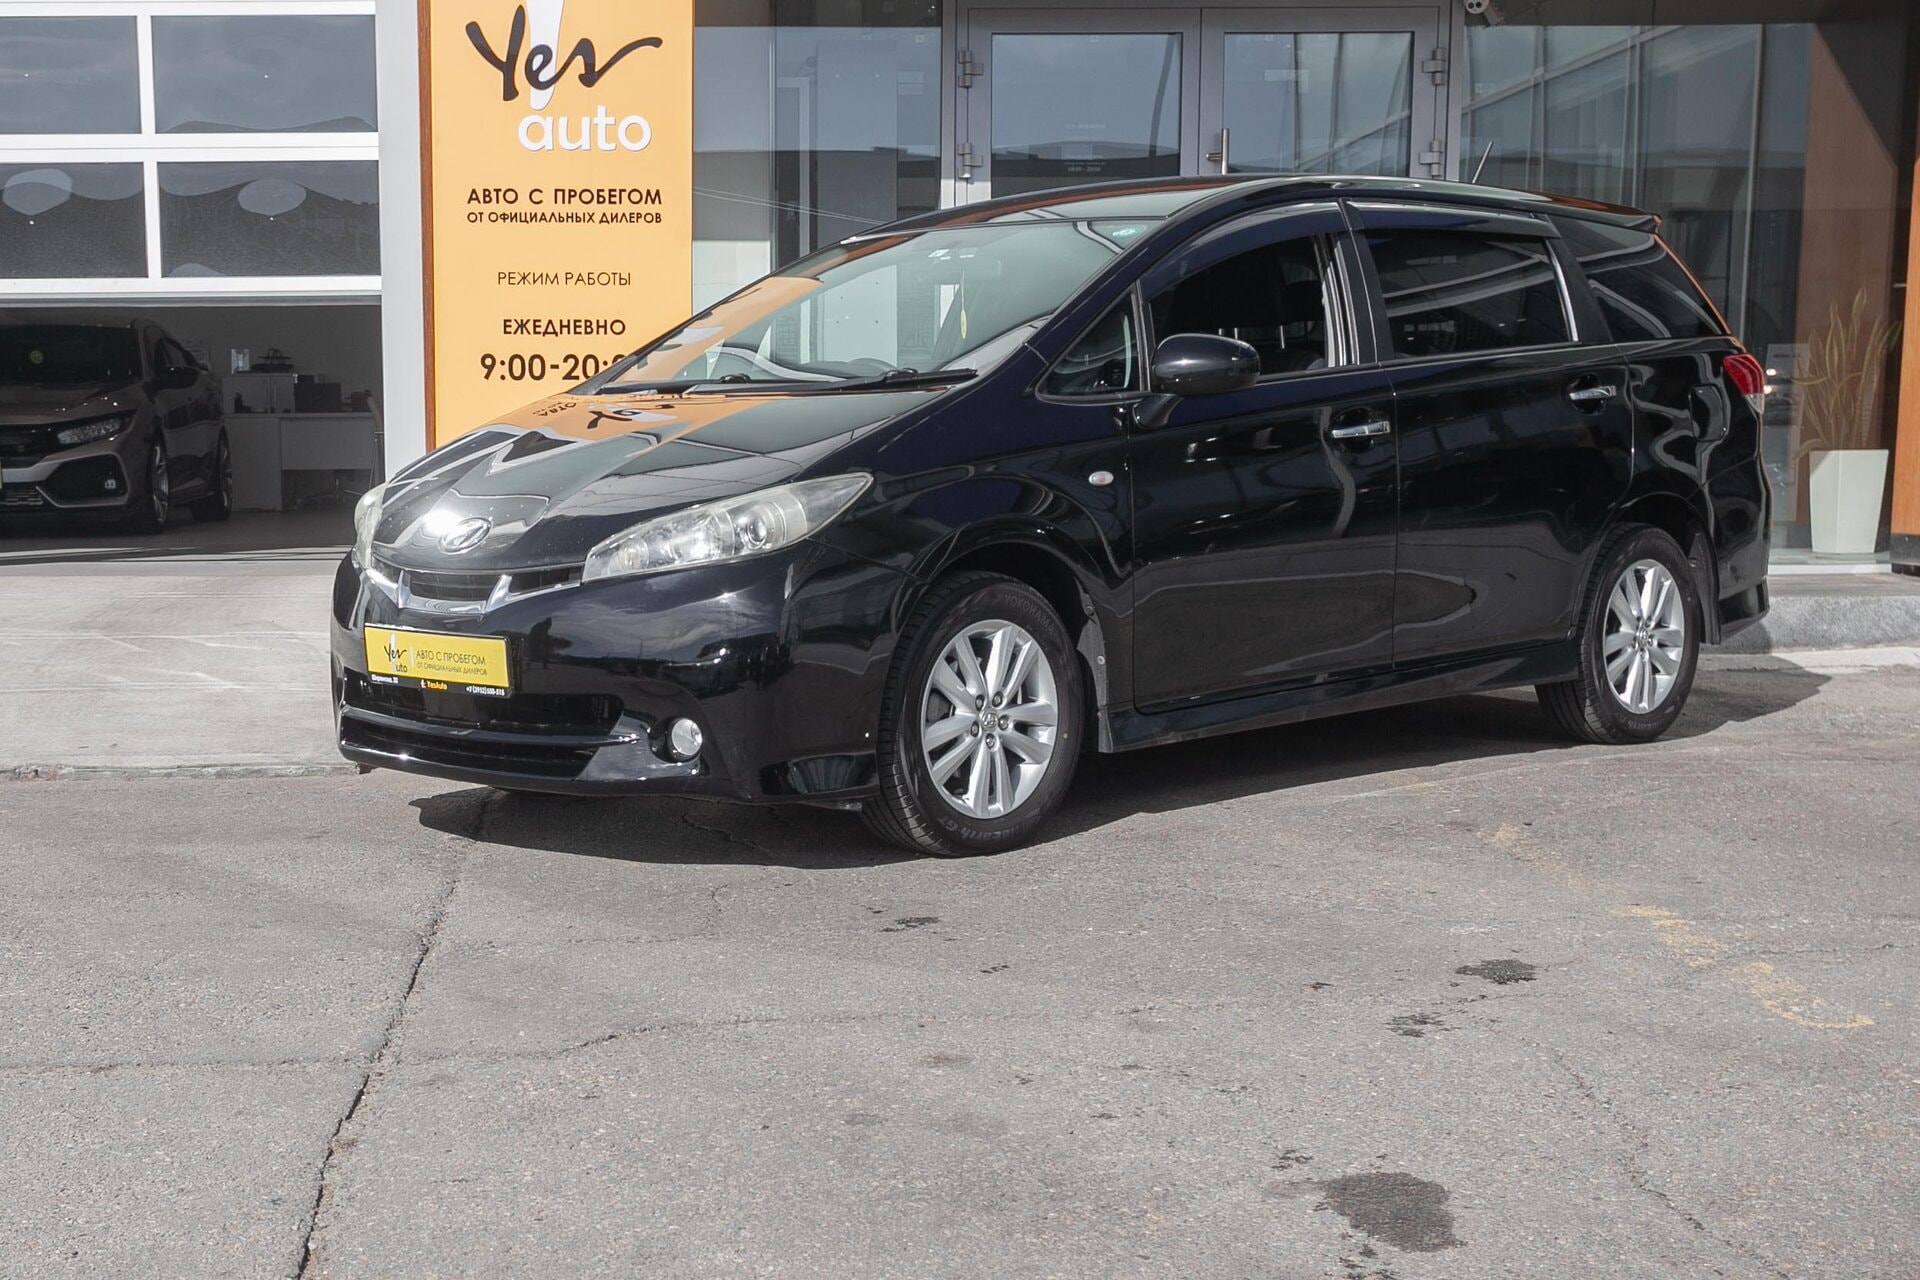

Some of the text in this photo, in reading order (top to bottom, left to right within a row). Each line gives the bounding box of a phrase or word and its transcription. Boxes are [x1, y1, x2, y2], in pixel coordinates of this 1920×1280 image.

[465, 4, 663, 101] Yes
[518, 104, 652, 152] auto
[467, 188, 662, 205] АВТО С ПРОБЕГОМ
[467, 211, 662, 224] ОТ ОФИЦИАЛЬНЫХ ДИЛЕРОВ
[498, 271, 631, 286] РЕЖИМ РАБОТЫ
[503, 319, 626, 337] ЕЖЕДНЕВНО
[416, 650, 486, 665] АВТО С ПРОБЕГОМ
[392, 663, 407, 673] uto
